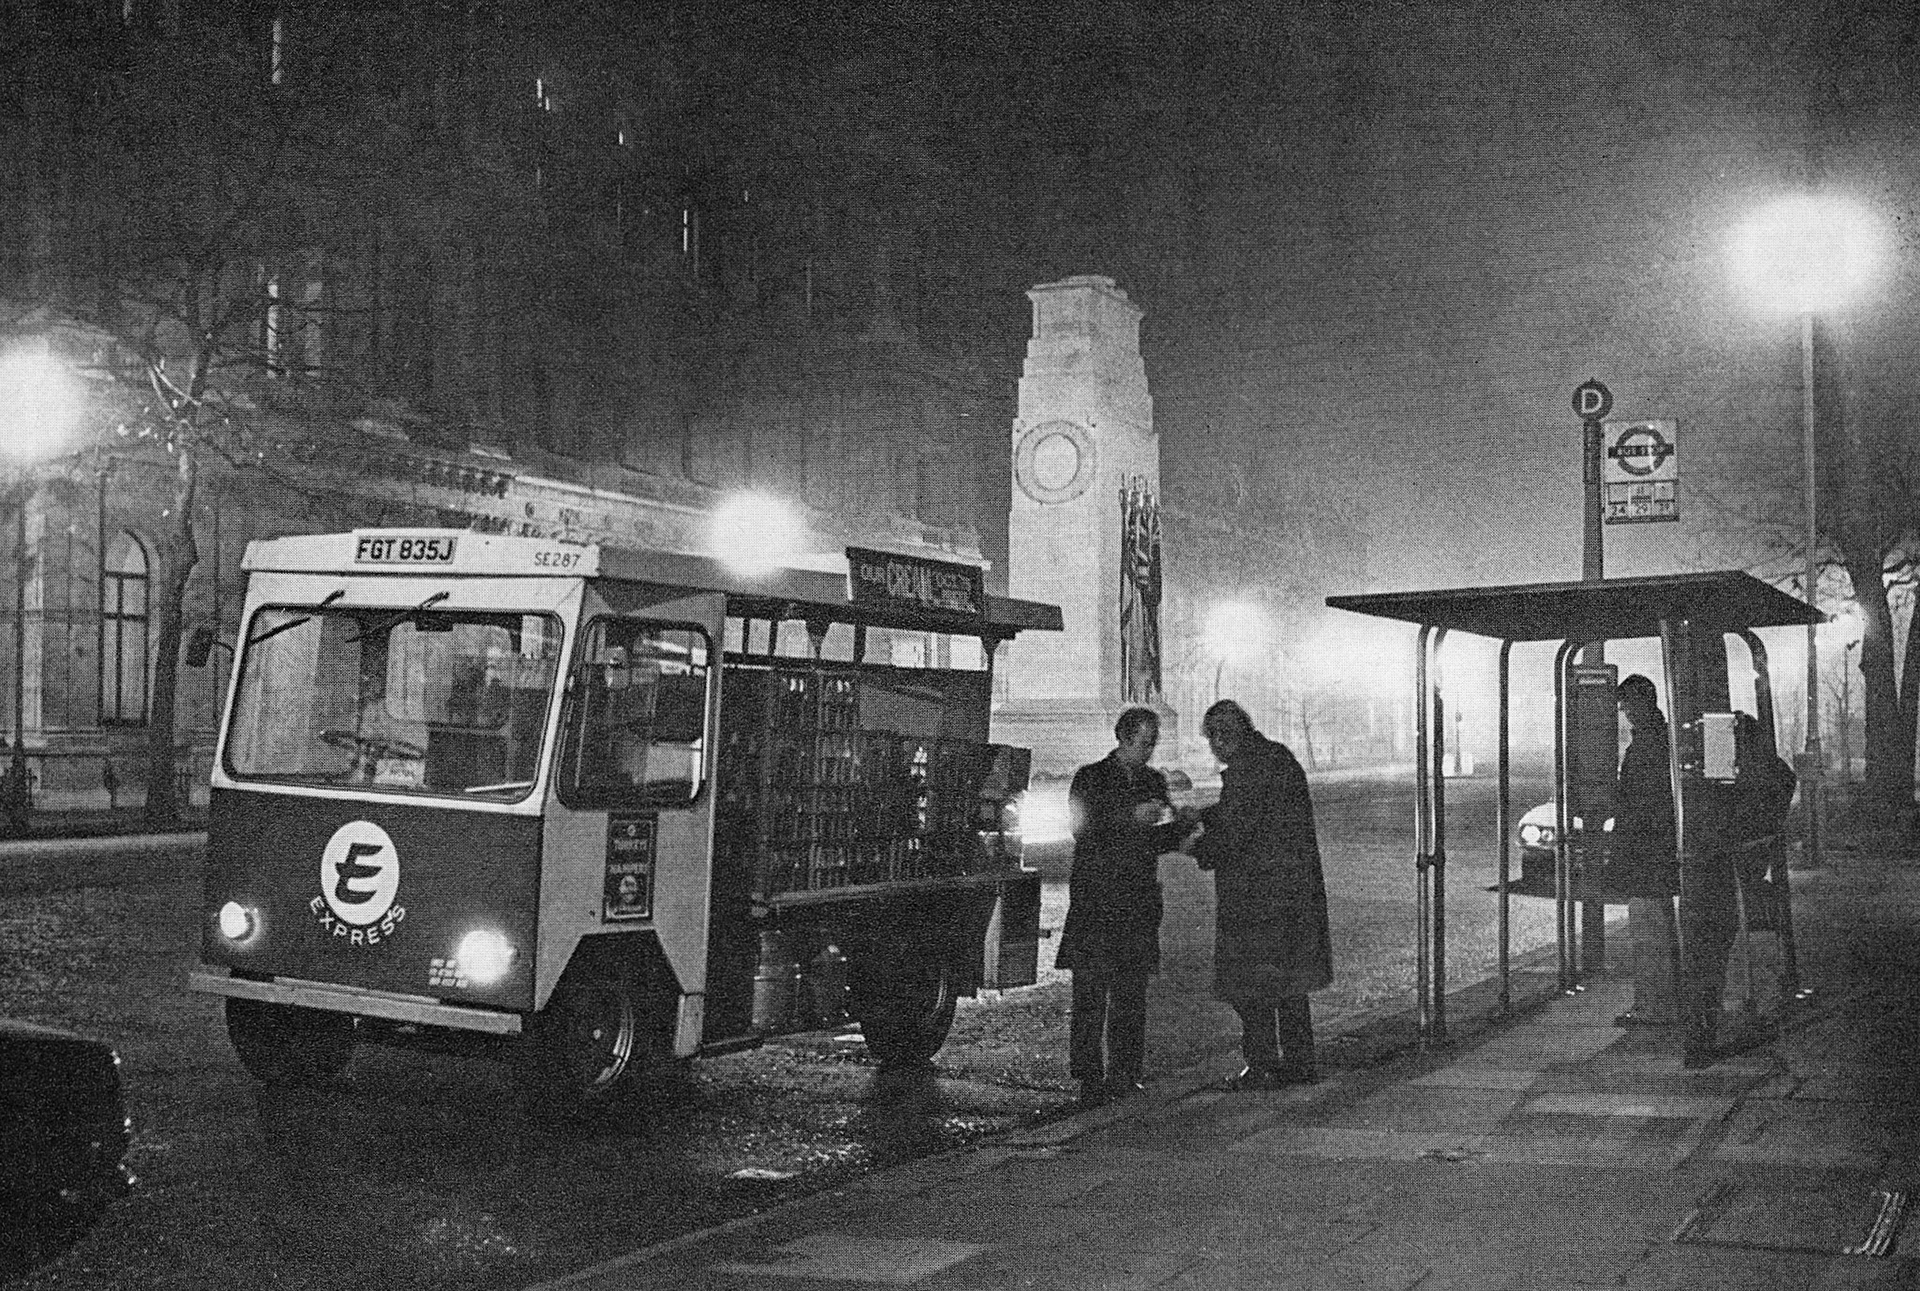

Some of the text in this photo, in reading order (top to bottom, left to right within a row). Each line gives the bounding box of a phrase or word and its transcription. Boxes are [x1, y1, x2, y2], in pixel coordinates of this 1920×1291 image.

[1581, 388, 1603, 413] D
[1611, 503, 1626, 515] 24
[357, 539, 454, 561] FGT 835J
[534, 552, 581, 569] SE287
[334, 842, 384, 905] E
[310, 895, 406, 946] EXPRESS
